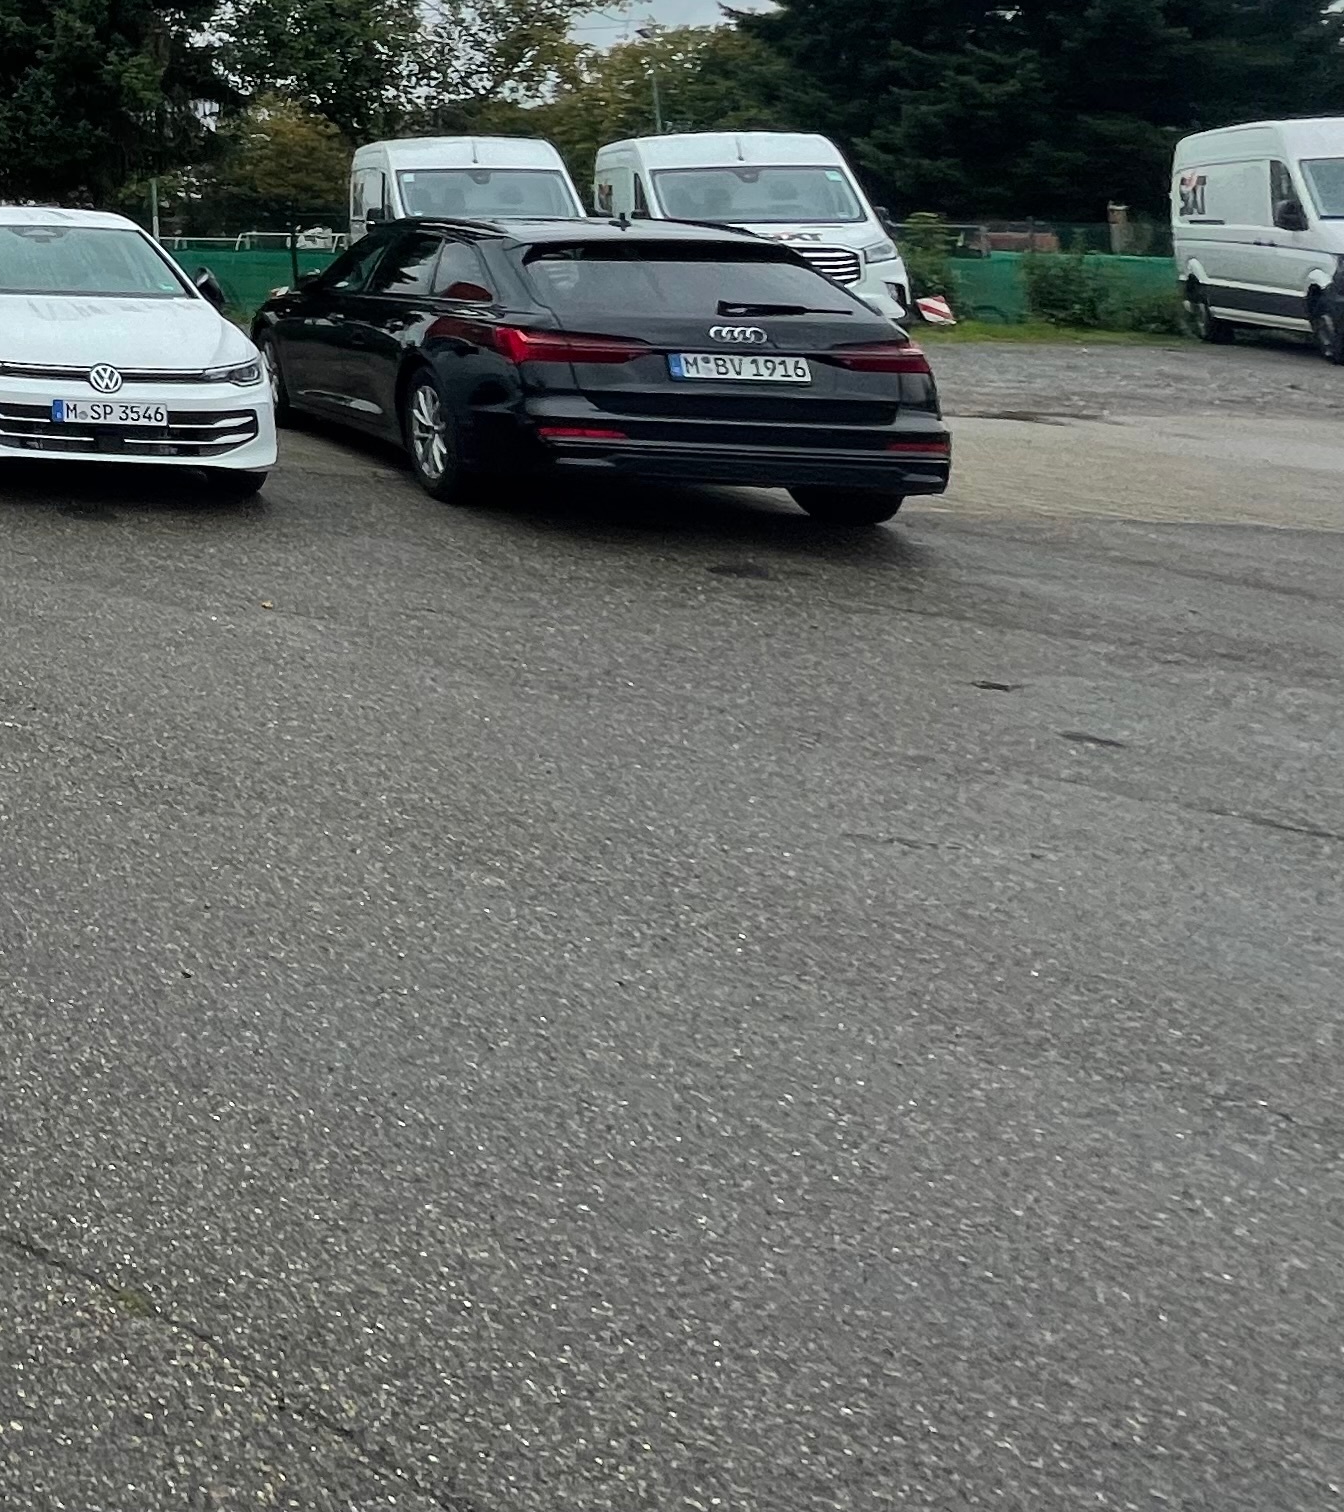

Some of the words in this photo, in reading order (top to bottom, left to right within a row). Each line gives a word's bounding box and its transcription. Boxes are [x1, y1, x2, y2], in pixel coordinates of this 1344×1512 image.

[684, 356, 700, 374] M
[714, 357, 743, 376] BV
[750, 359, 807, 379] 1916
[66, 403, 78, 420] M
[90, 404, 114, 421] SP
[118, 405, 165, 423] 3546
